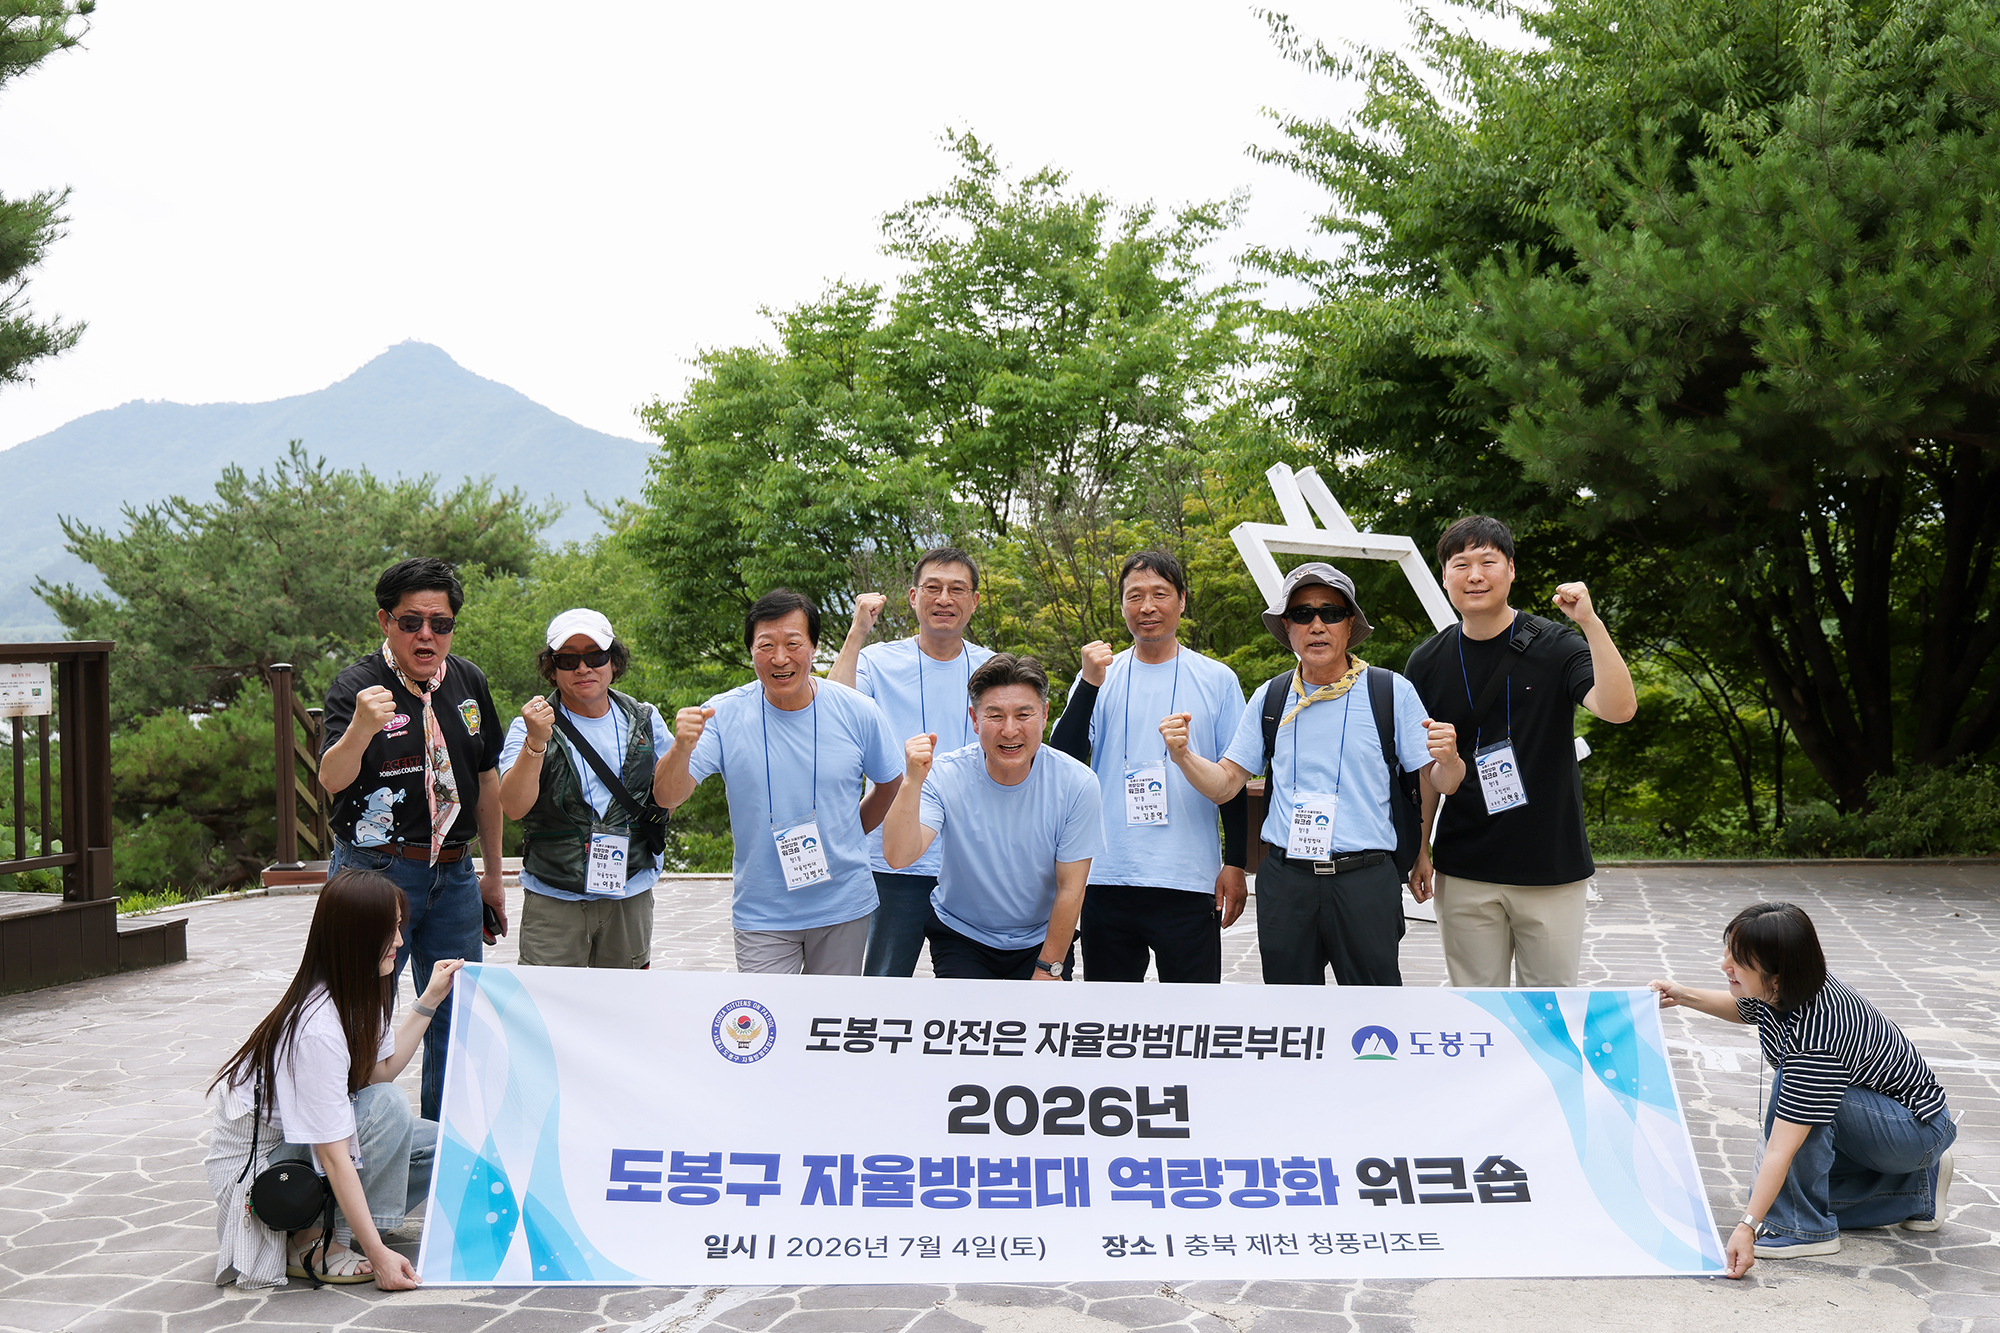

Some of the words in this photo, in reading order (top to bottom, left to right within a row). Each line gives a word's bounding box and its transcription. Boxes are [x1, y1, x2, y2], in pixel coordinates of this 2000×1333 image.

[715, 1011, 727, 1027] KOREA
[726, 1000, 751, 1010] CITIZENS
[761, 1009, 774, 1028] PATROL
[805, 1017, 912, 1054] 도봉구
[922, 1020, 1026, 1056] 안전은
[1035, 1021, 1326, 1061] 자율방범대로부터!
[1410, 1031, 1494, 1057] 도봉구
[948, 1084, 1190, 1139] 2026년
[606, 1148, 782, 1206] 도봉구
[800, 1153, 1091, 1209] 자율방범대
[1108, 1156, 1340, 1209] 역량강화
[1356, 1154, 1532, 1206] 워크숍
[704, 1234, 756, 1259] 일시
[787, 1235, 888, 1258] 2026년
[898, 1236, 942, 1258] 7월
[951, 1236, 1046, 1261] 4일(토)
[1102, 1234, 1156, 1257] 장소
[1184, 1234, 1237, 1256] 충북
[1245, 1233, 1300, 1255] 제천
[1307, 1232, 1445, 1255] 청풍리조트
